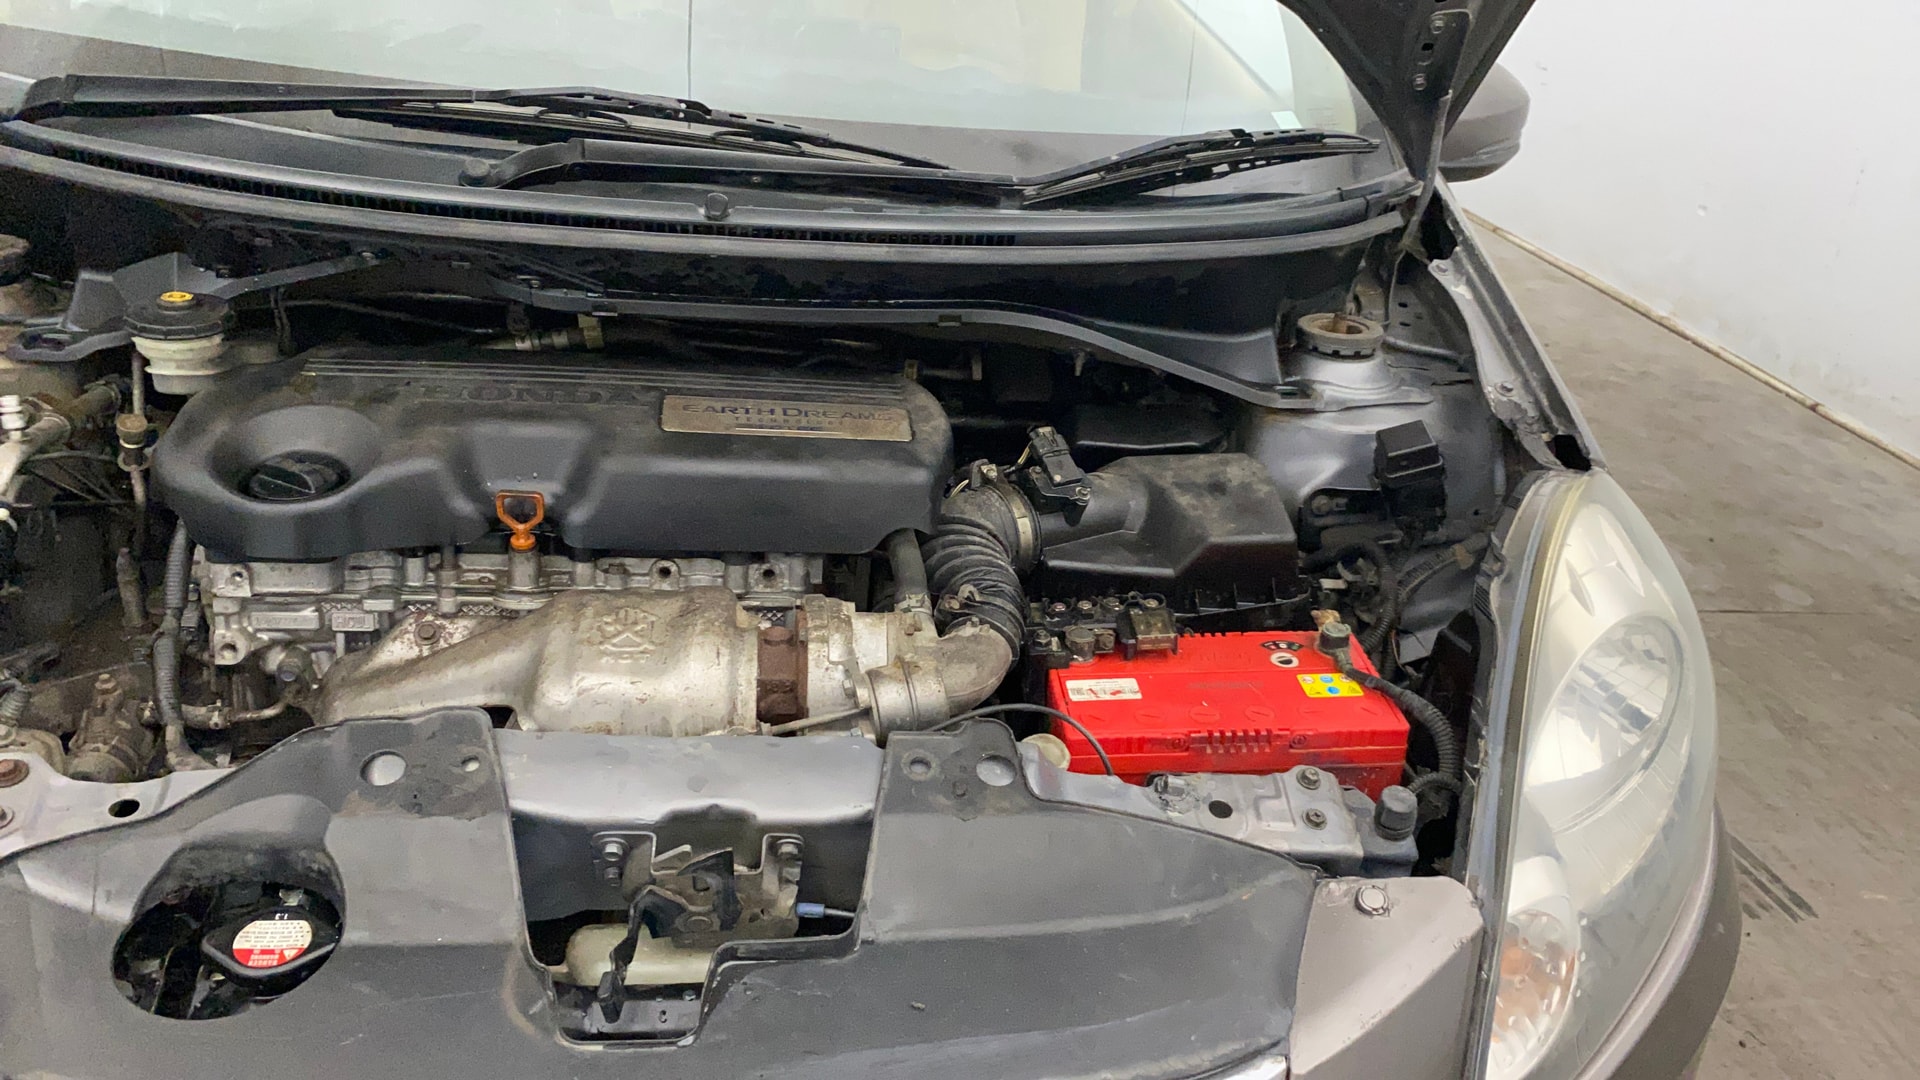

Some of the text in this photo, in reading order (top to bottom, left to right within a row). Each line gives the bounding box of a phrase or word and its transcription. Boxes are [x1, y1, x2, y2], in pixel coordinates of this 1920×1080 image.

[414, 382, 653, 407] HONDA
[682, 404, 893, 420] EARTH DREAMS
